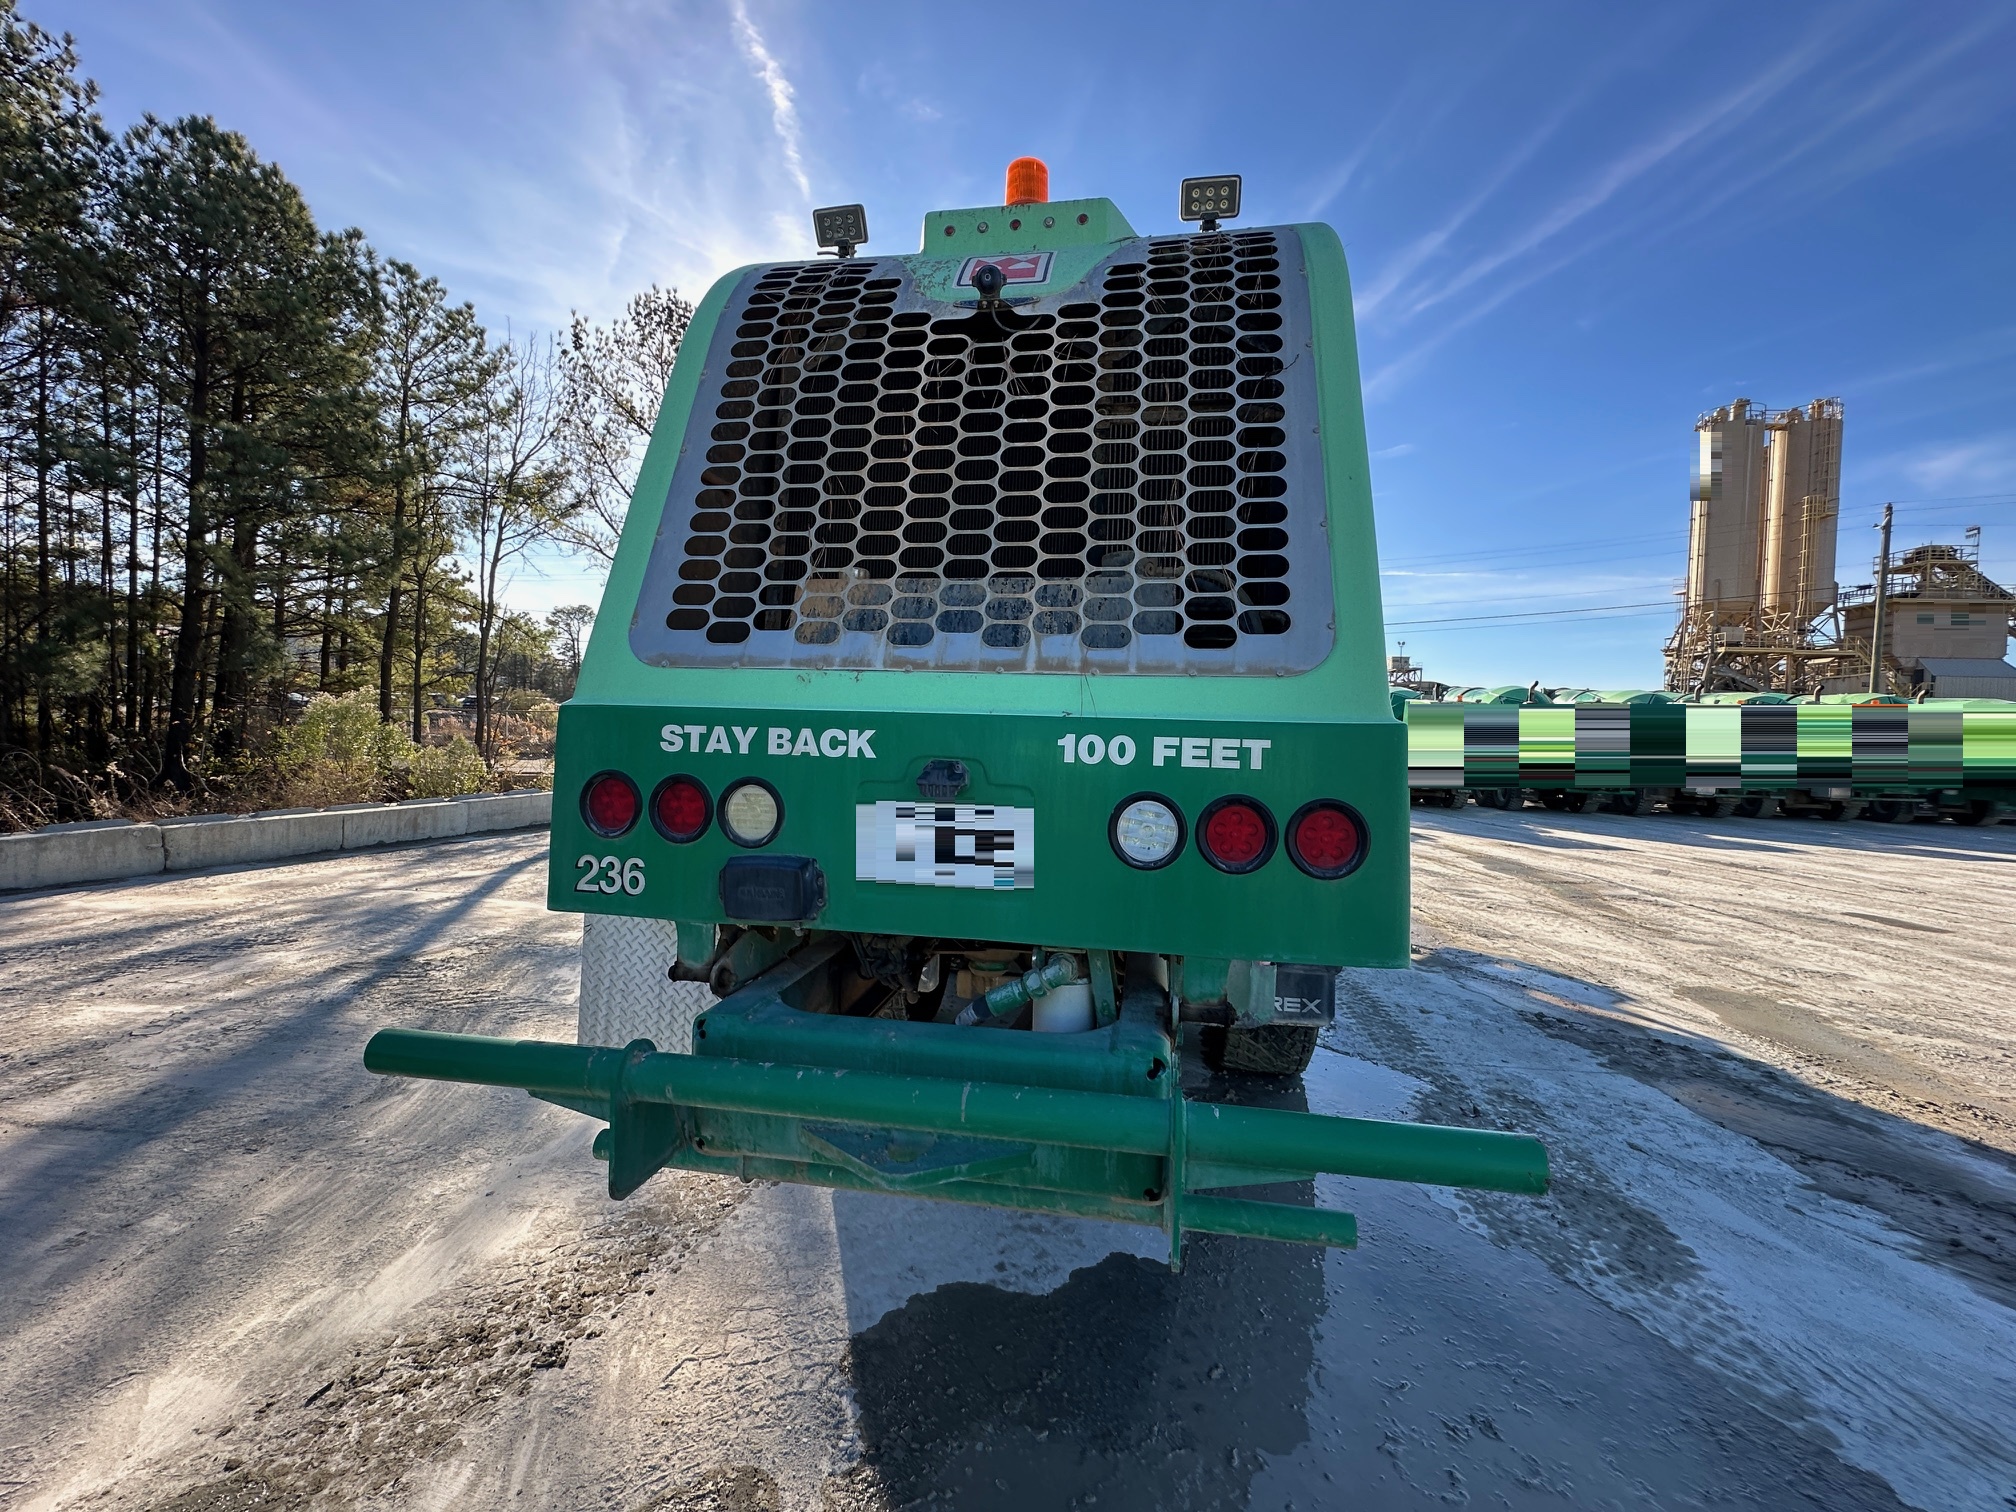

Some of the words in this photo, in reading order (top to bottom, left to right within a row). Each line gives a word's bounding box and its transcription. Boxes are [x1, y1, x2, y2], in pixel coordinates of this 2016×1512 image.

[660, 724, 758, 755] STAY
[767, 727, 877, 759] BACK
[1057, 733, 1137, 766] 100
[1152, 736, 1272, 770] FEET
[575, 854, 646, 896] 236
